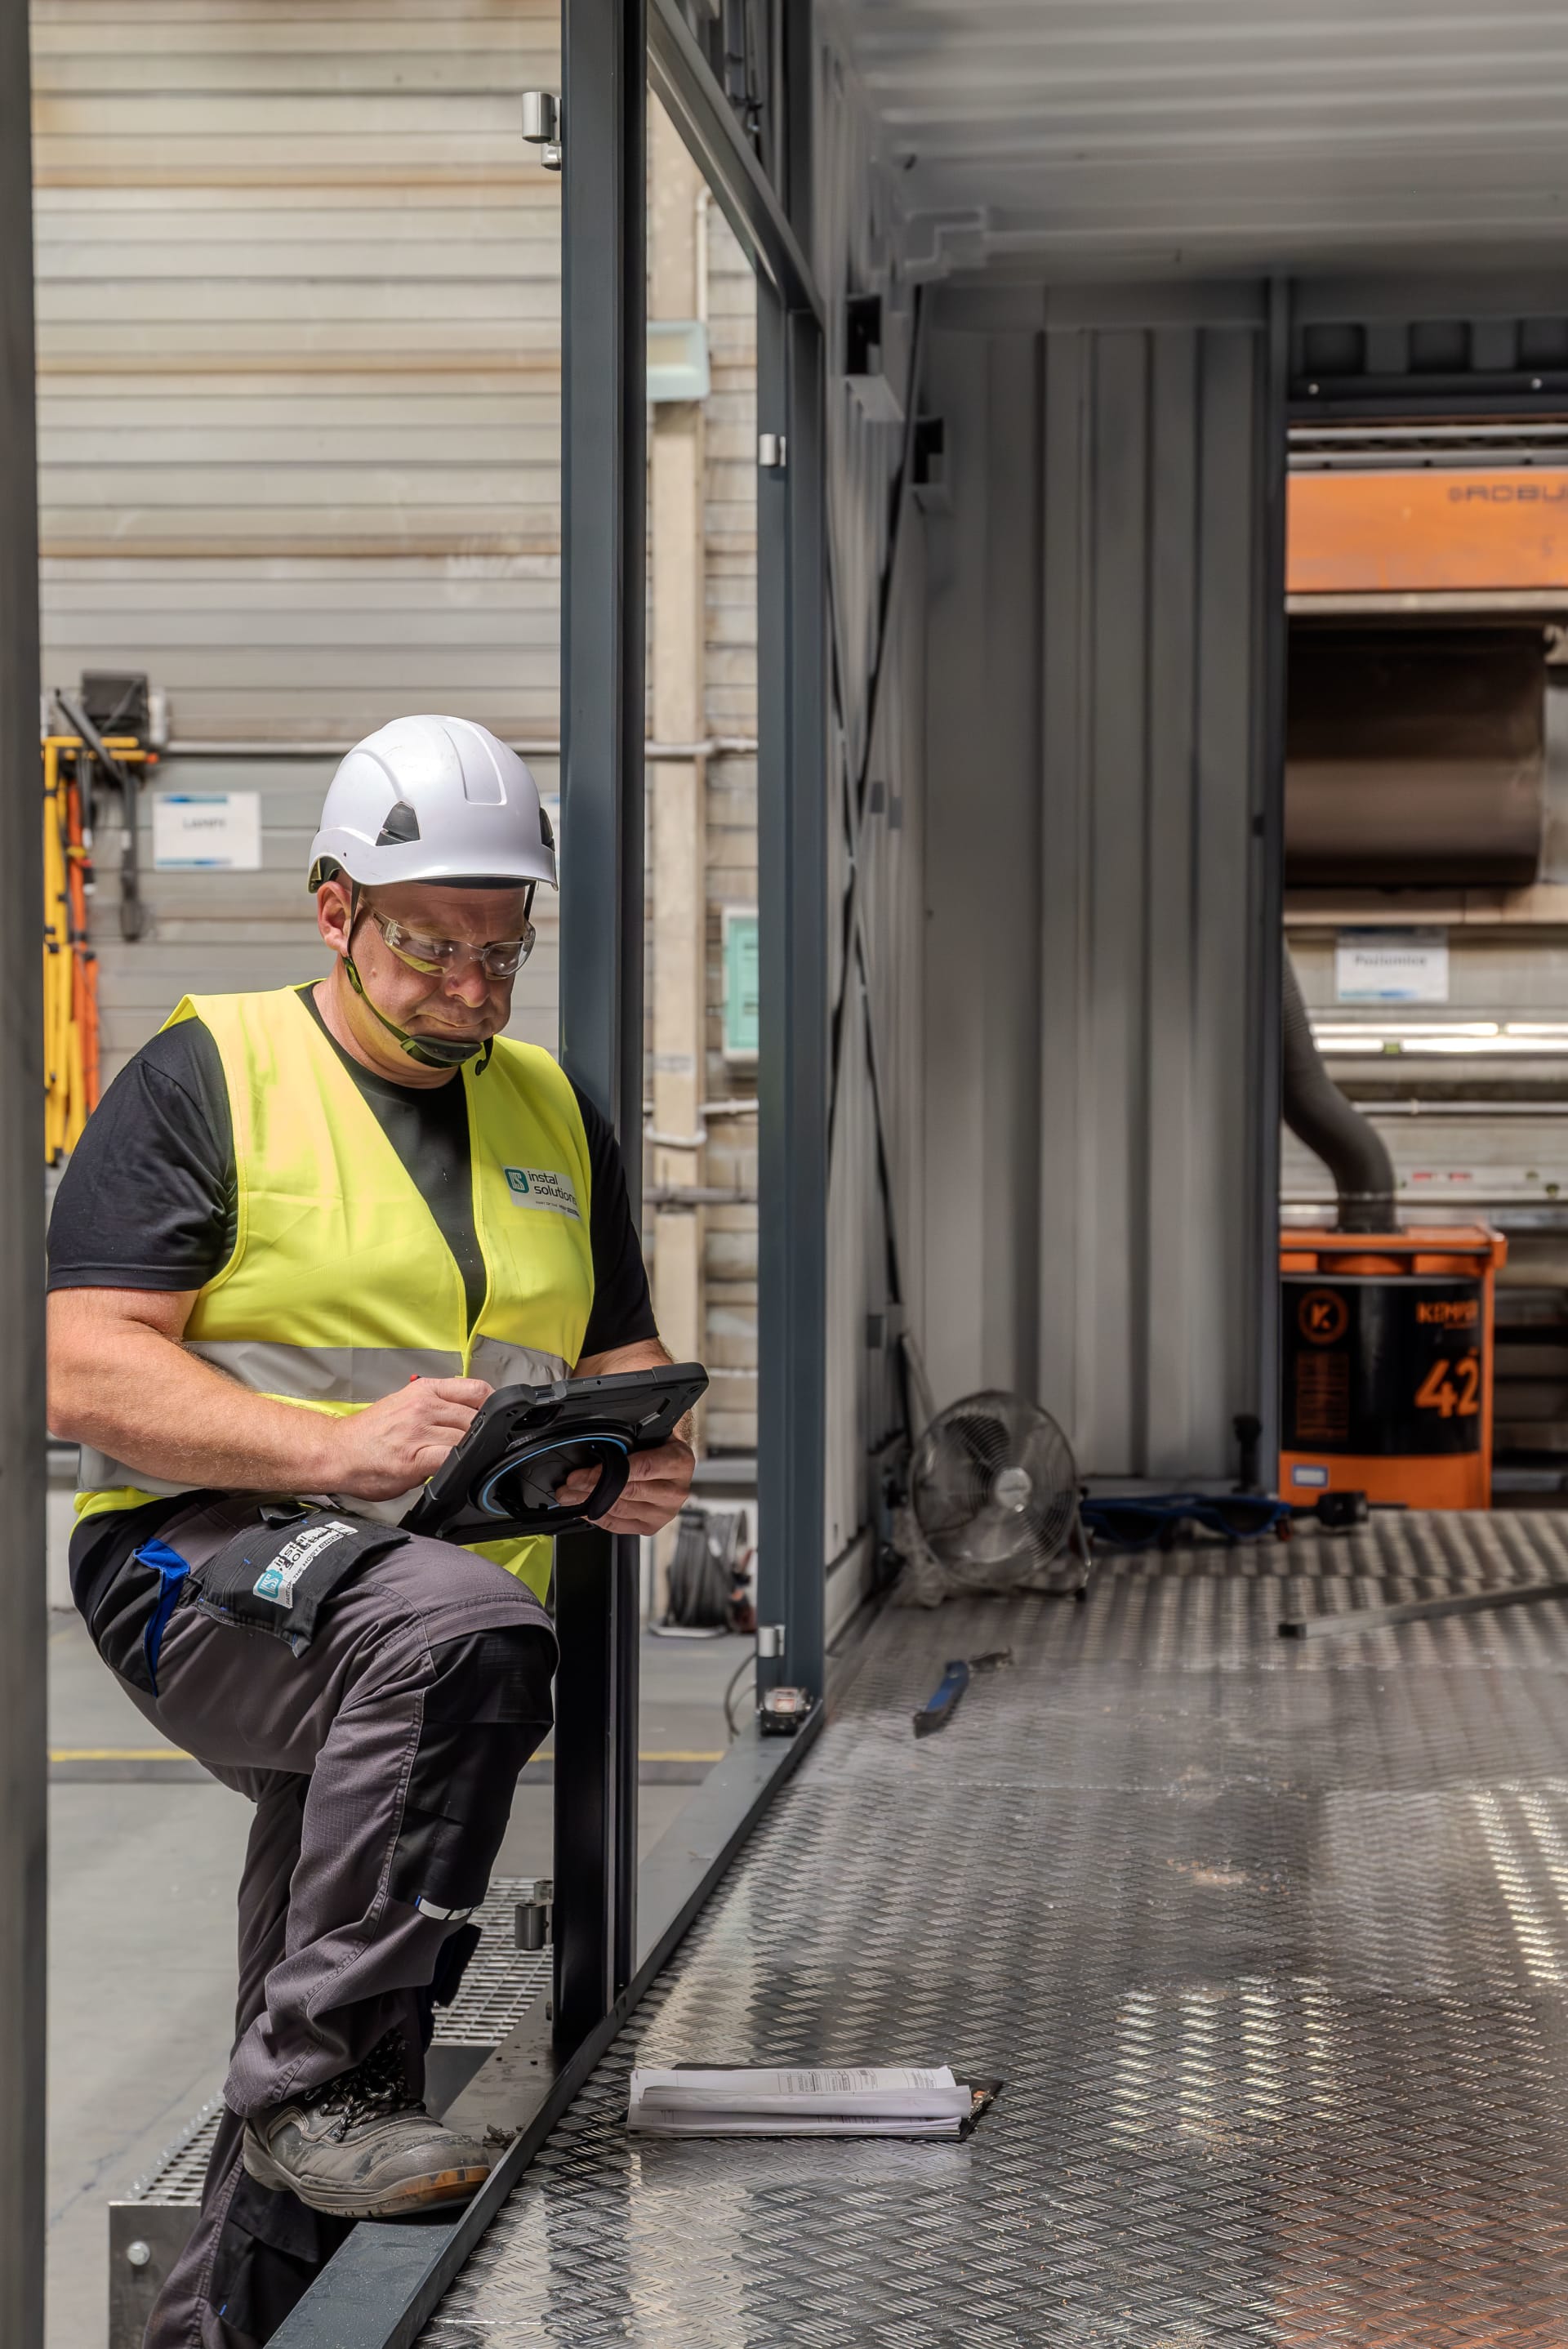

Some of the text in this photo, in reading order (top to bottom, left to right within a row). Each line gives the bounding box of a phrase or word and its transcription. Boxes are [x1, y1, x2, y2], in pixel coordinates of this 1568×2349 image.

[527, 1170, 559, 1185] instal
[534, 1185, 577, 1206] solutions
[1414, 1356, 1479, 1418] 42
[292, 1567, 304, 1580] THE
[302, 1548, 319, 1567] HOST
